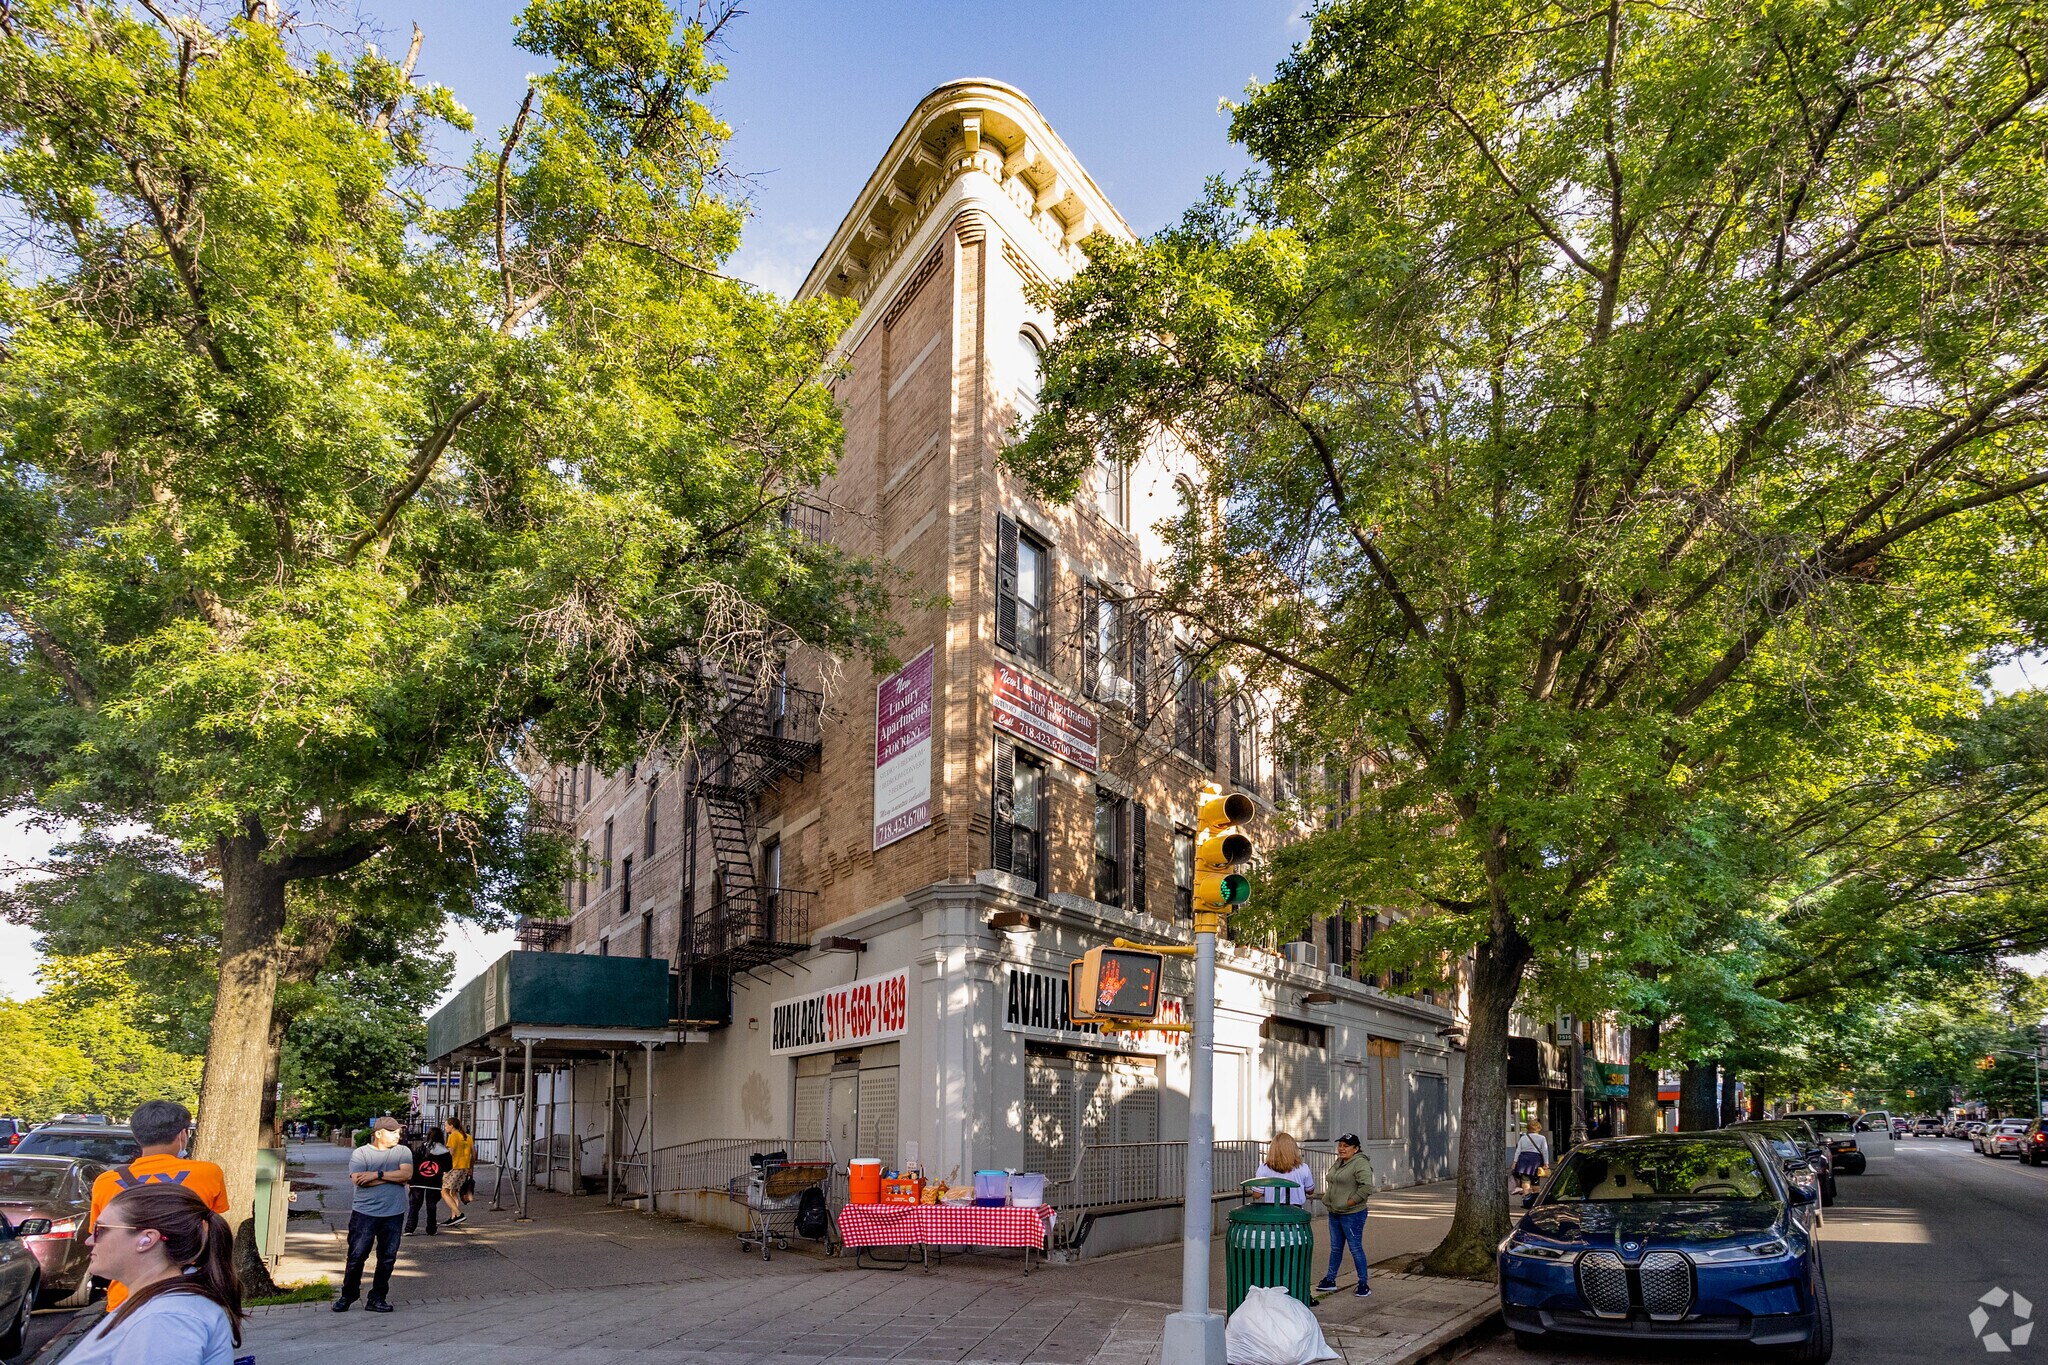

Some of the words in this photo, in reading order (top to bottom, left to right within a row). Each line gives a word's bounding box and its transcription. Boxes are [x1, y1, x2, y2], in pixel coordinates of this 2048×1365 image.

[889, 687, 920, 717] Luxury
[895, 677, 911, 694] New
[999, 668, 1017, 687] New
[1017, 675, 1048, 706] Luxury
[1048, 695, 1092, 729] Apartments
[880, 701, 928, 742] Apartments
[1030, 701, 1045, 717] FOR
[1047, 711, 1067, 729] RENT
[884, 739, 901, 759] FOR
[901, 725, 923, 749] RENT
[998, 713, 1014, 727] Call
[1019, 722, 1071, 756] 718.423.6700
[879, 806, 927, 842] 718.423.6700
[773, 995, 826, 1050] AVAILABLE
[827, 975, 906, 1042] 917-660-1499
[1007, 970, 1097, 1035] AVAILA
